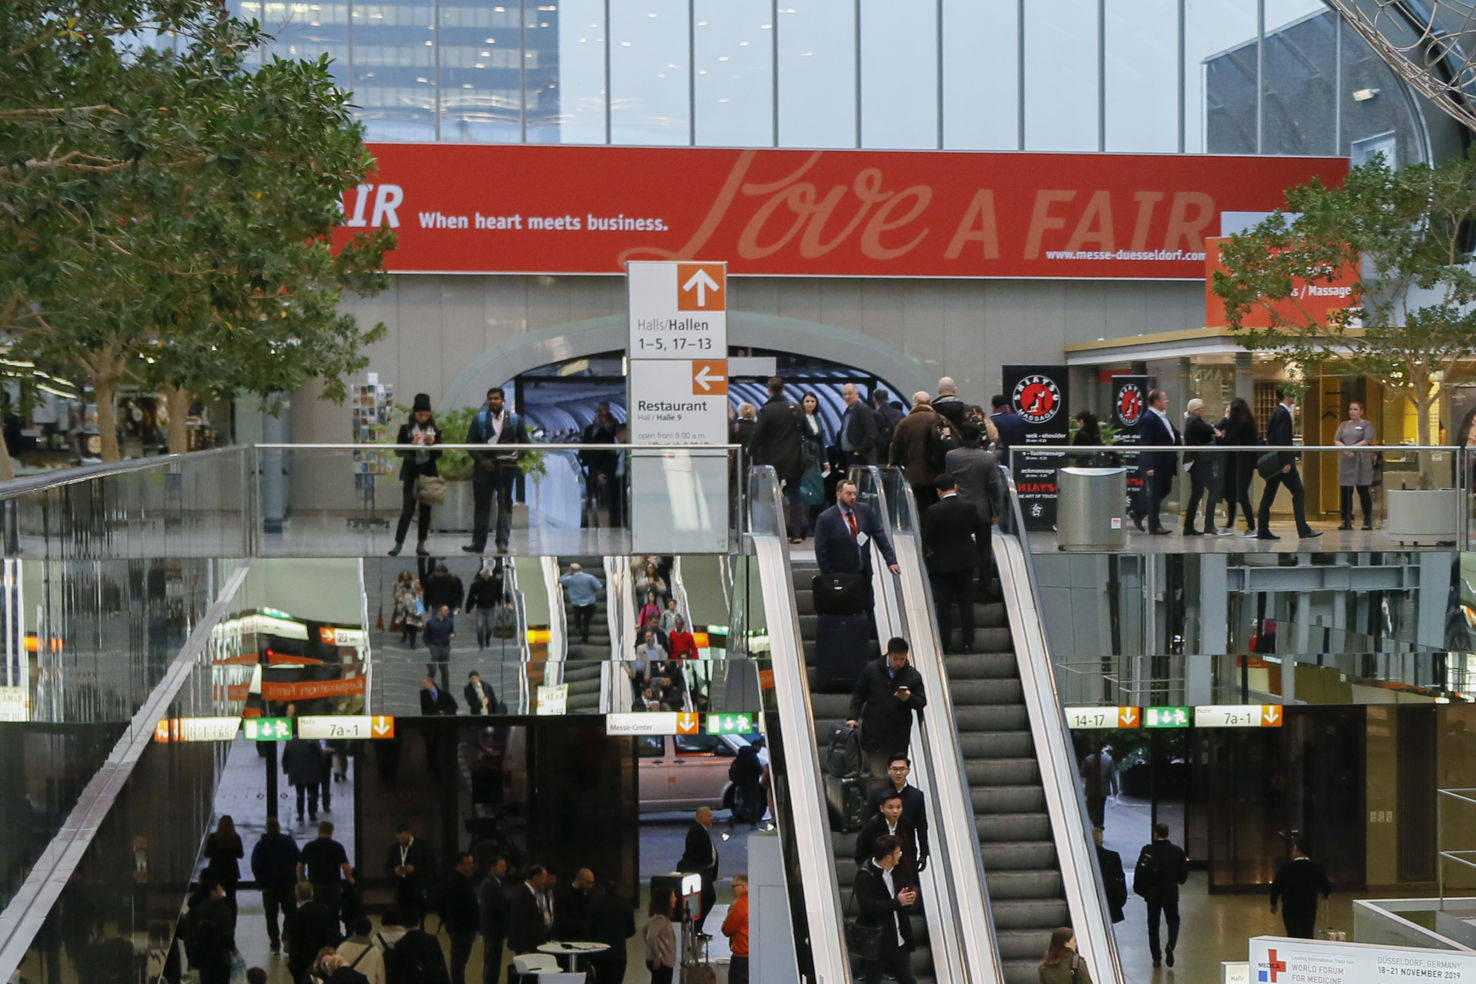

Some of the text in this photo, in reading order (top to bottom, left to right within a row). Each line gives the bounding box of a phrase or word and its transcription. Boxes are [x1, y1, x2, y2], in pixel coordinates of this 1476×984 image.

[419, 213, 669, 232] When heart meets business.
[944, 189, 999, 260] A
[1023, 190, 1216, 260] FAIR
[1046, 249, 1206, 261] www.messe-duesseldorf.com
[1308, 285, 1352, 298] Massage
[637, 319, 709, 331] Halls/Hallen
[638, 400, 707, 411] Restaurant
[1017, 408, 1056, 422] MASSAGE
[1074, 714, 1105, 727] 14-17
[610, 723, 653, 732] Messe-Center
[1427, 960, 1462, 969] GERMANY
[1319, 967, 1344, 975] FORUM
[1401, 969, 1442, 978] NOVEMBER
[1308, 976, 1342, 984] MEDICINE
